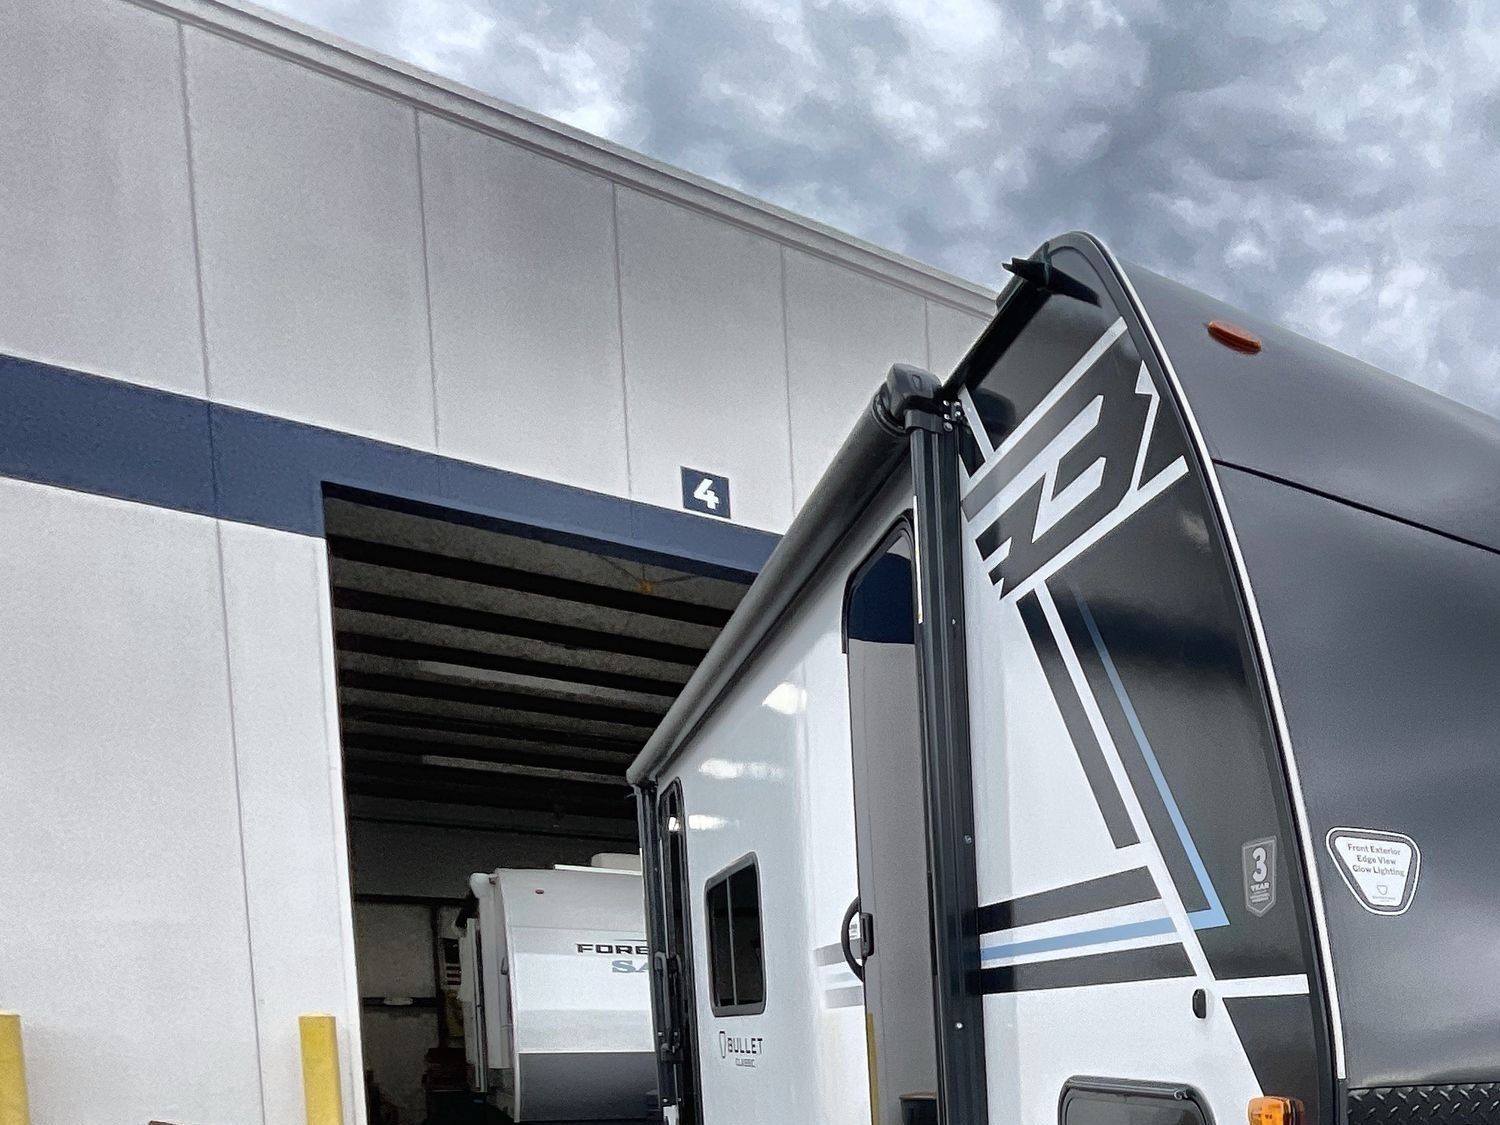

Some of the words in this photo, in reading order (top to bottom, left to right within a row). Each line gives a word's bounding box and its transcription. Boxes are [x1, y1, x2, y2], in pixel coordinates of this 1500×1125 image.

[693, 478, 719, 510] 4
[1252, 847, 1267, 882] 3
[1373, 867, 1405, 877] Lighting
[727, 1038, 763, 1054] BULLET
